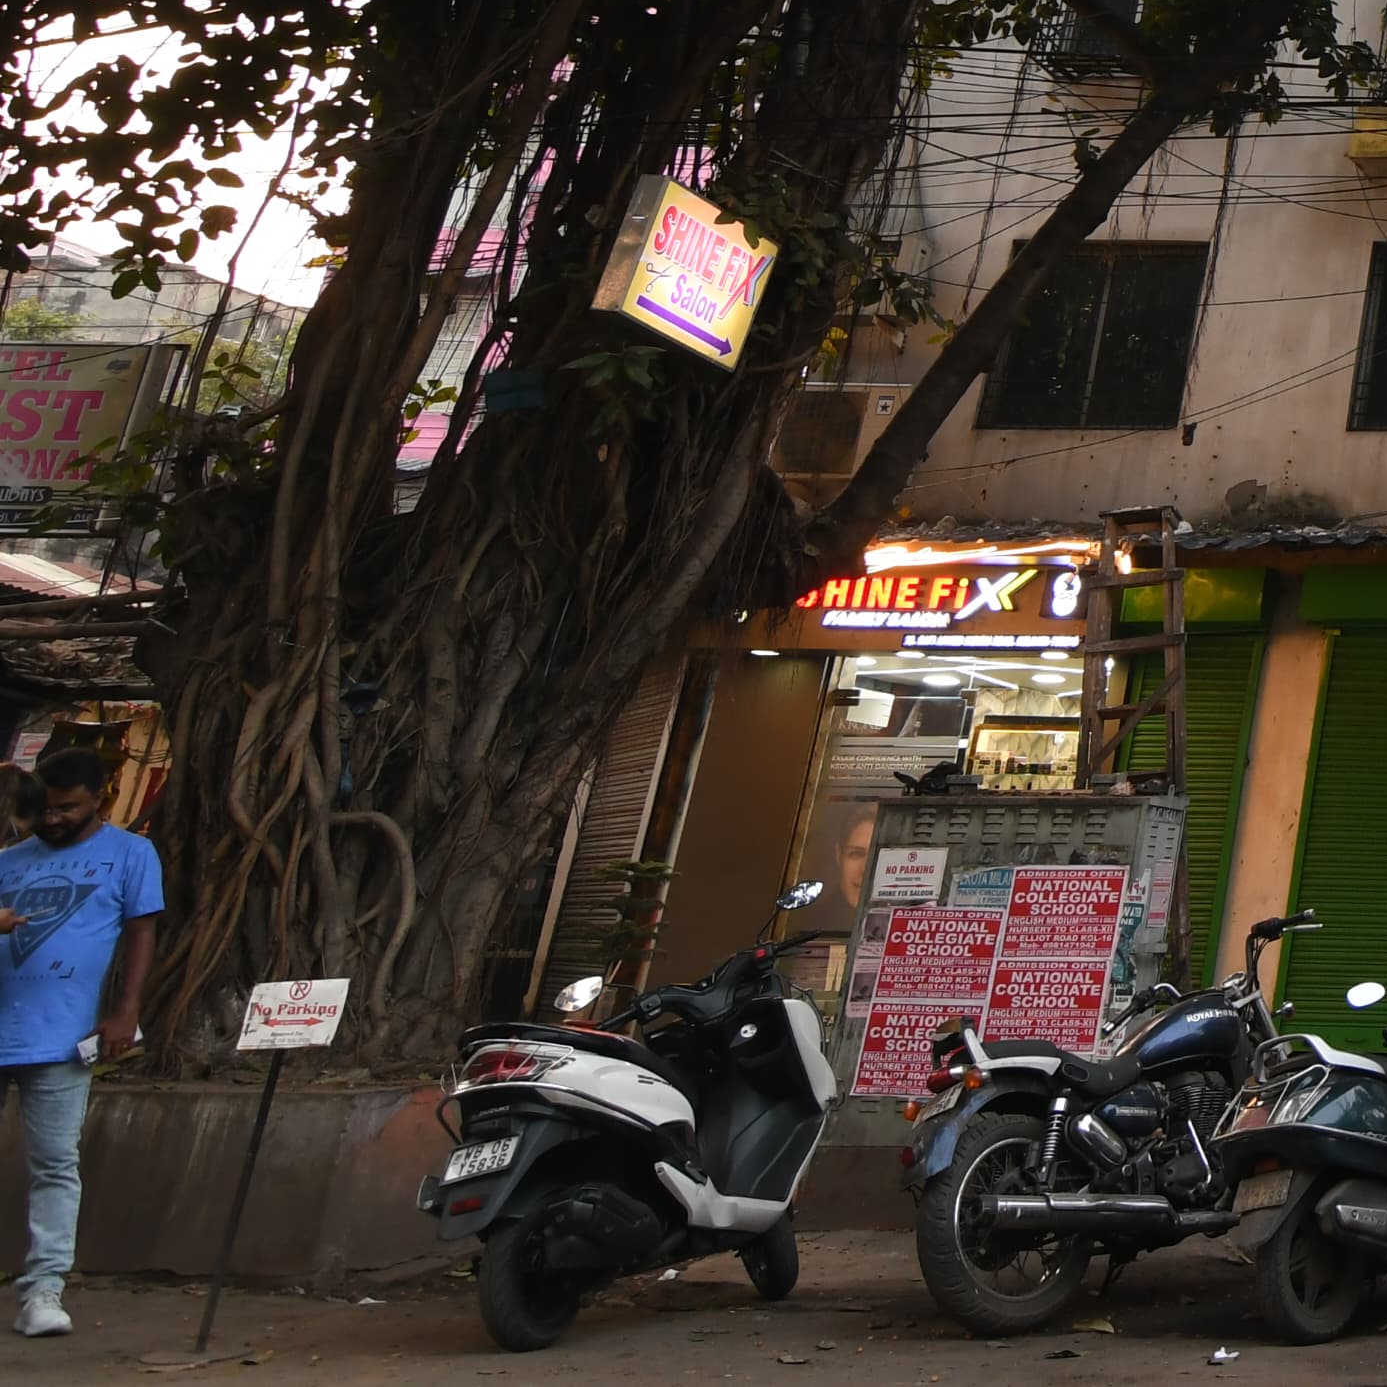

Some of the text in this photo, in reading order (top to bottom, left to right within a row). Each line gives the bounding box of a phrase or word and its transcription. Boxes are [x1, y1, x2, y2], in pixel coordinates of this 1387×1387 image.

[653, 205, 726, 285] SHINE
[670, 273, 718, 325] Salon
[0, 389, 104, 442] ST
[886, 865, 935, 875] NO PARKING
[1030, 880, 1112, 891] NATIONAL
[1014, 892, 1119, 903] COLLEGIATE
[895, 910, 1000, 919] ADMISSION OPEN
[1030, 904, 1097, 915] SCHOOL
[906, 920, 989, 933] NATIONAL
[1008, 917, 1045, 925] ENGLISH
[1046, 917, 1080, 925] MEDIUM
[891, 932, 997, 945] COLLEGIATE
[906, 944, 972, 956] SCHOOL
[884, 956, 919, 965] ENGLISH
[921, 957, 955, 966] MEDIUM
[884, 966, 927, 974] NURSERY
[1011, 972, 1094, 983] NATIONAL
[995, 984, 1101, 996] COLLEGIATE
[1011, 996, 1078, 1008] SCHOOL
[253, 1002, 338, 1017] No Parking
[874, 1004, 944, 1012] ADMISSION
[990, 1009, 1025, 1018] ENGLISH
[1027, 1009, 1060, 1018] MEDIUM
[886, 1015, 948, 1027] NATION
[870, 1027, 936, 1039] COLLEG
[885, 1040, 931, 1051] SCHO
[863, 1052, 931, 1061] ENGLISH MEDIU
[491, 1138, 512, 1155] 06
